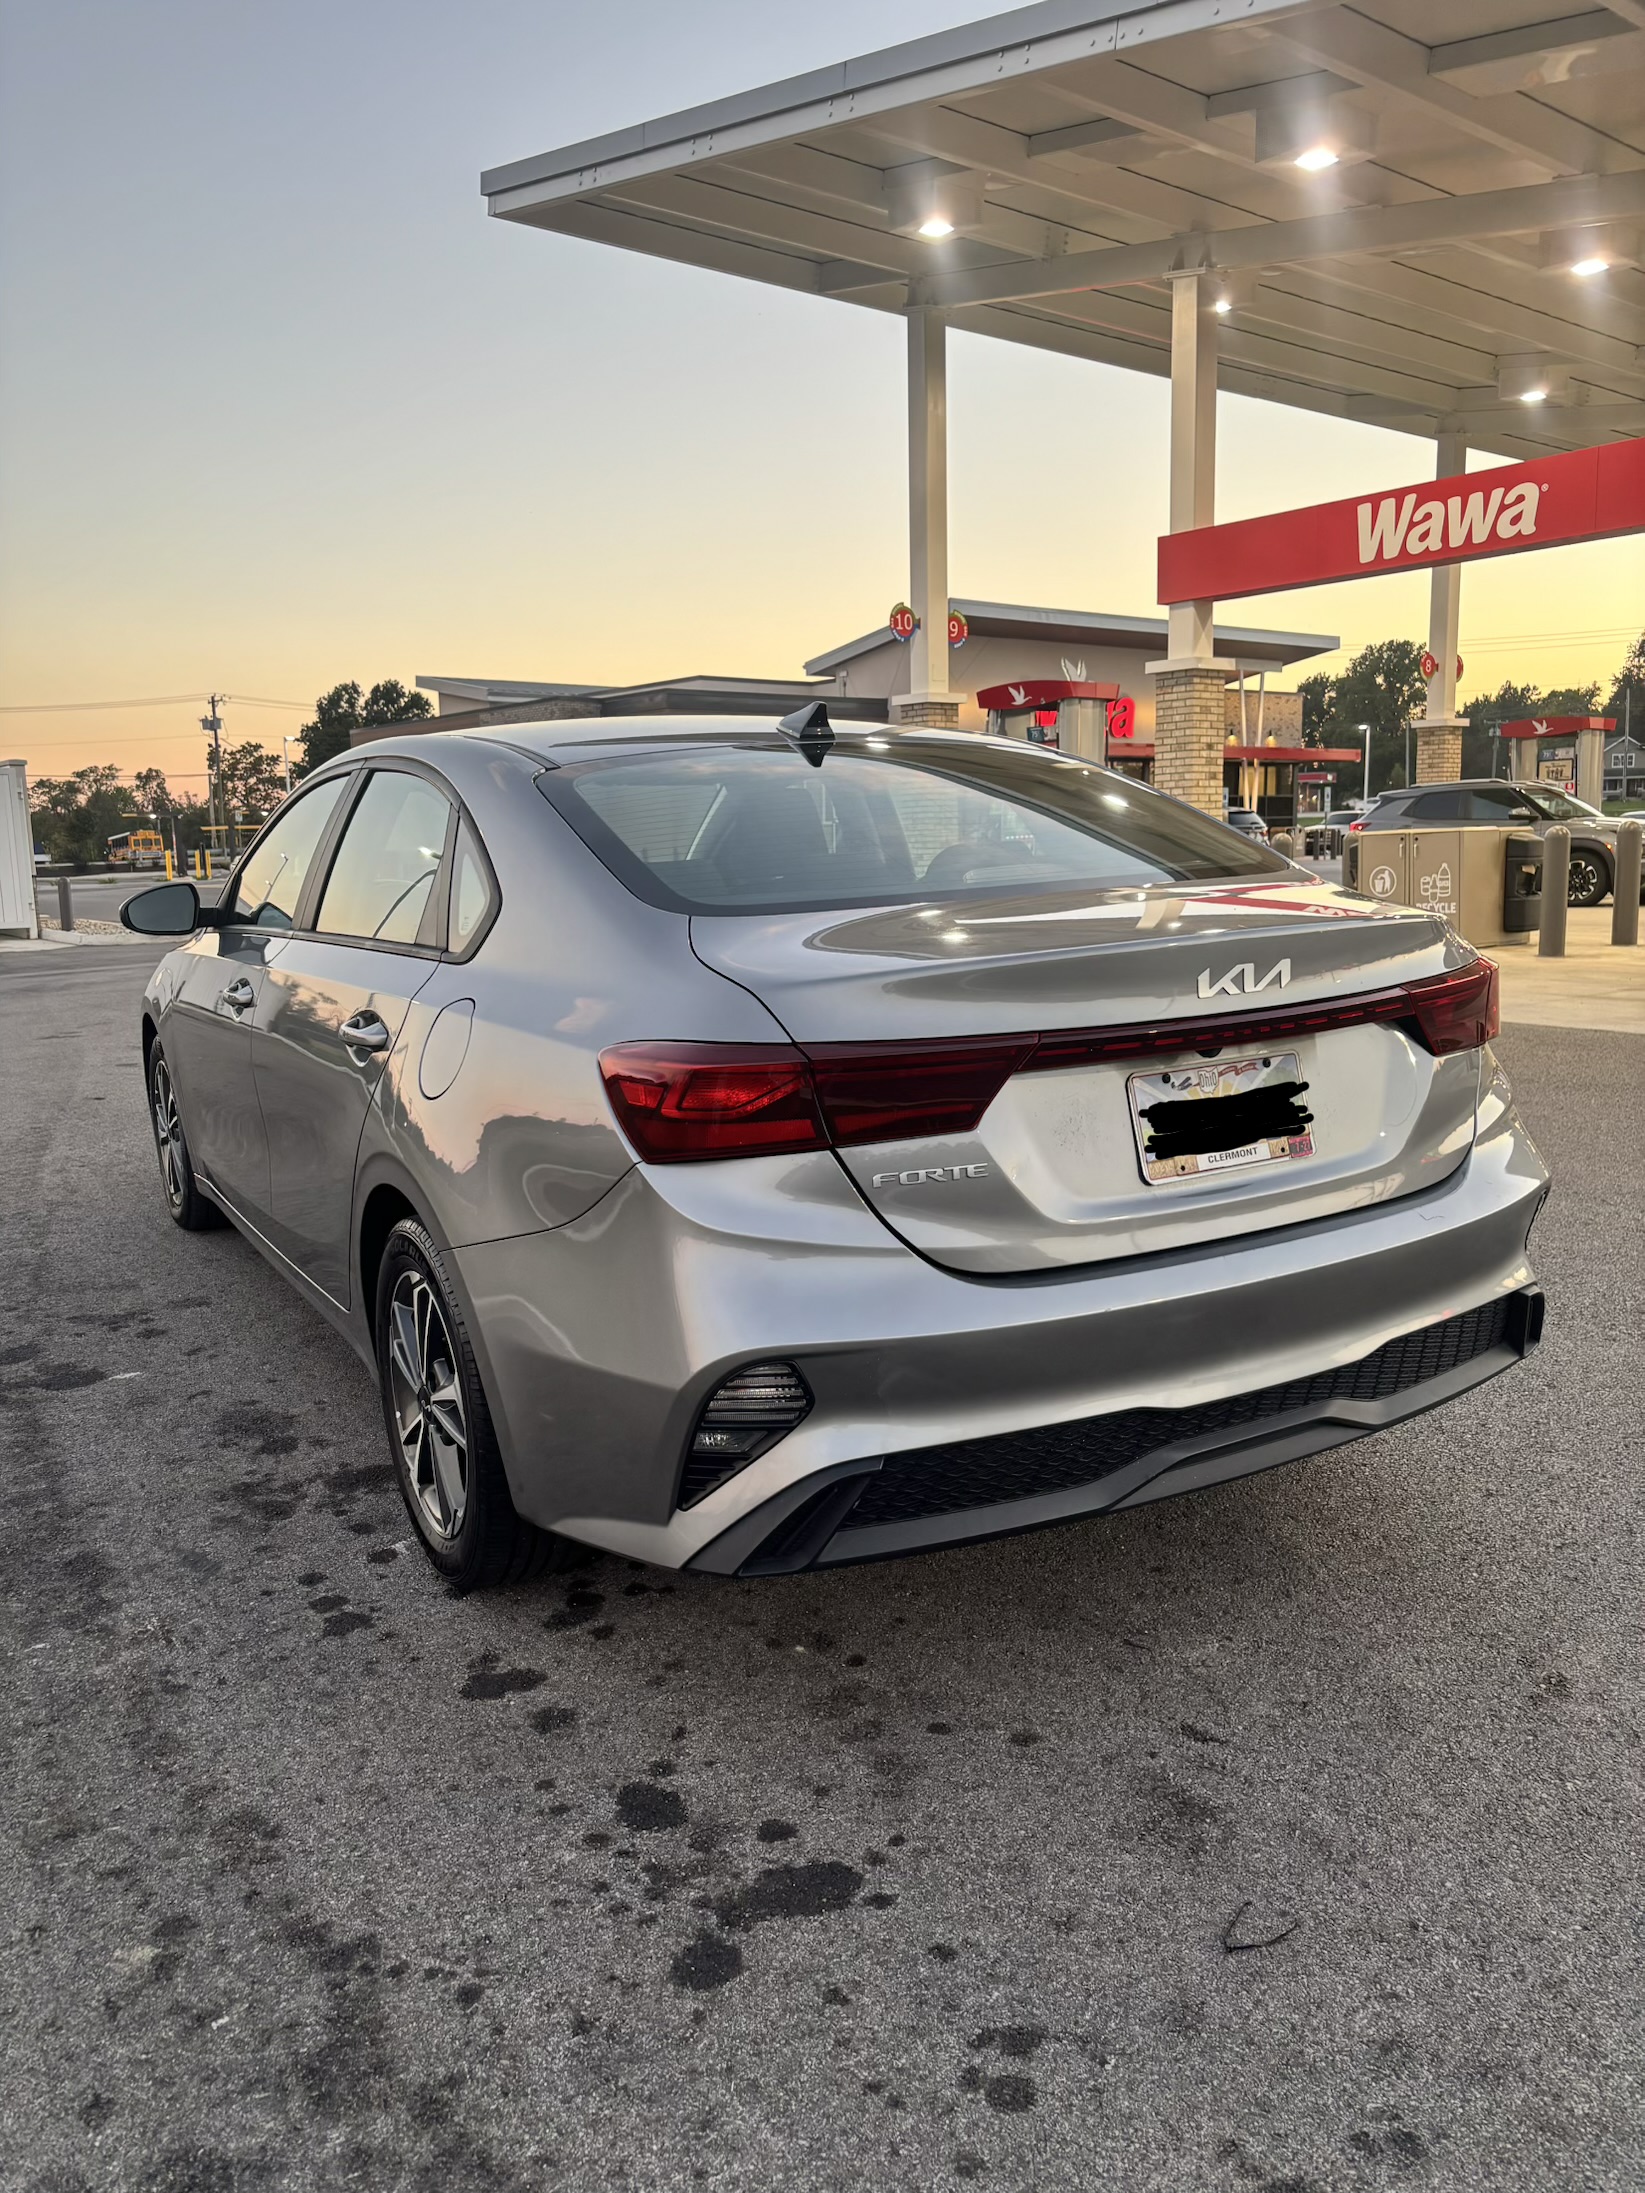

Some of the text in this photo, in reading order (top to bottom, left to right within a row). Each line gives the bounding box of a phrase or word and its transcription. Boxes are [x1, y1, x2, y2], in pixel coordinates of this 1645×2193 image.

[1357, 482, 1540, 564] Wawa
[896, 613, 913, 630] 10
[949, 621, 959, 637] 9
[1425, 659, 1432, 673] 8
[1197, 958, 1291, 999] KIA
[1207, 1147, 1258, 1164] CLERMONT
[872, 1162, 989, 1189] FORTE
